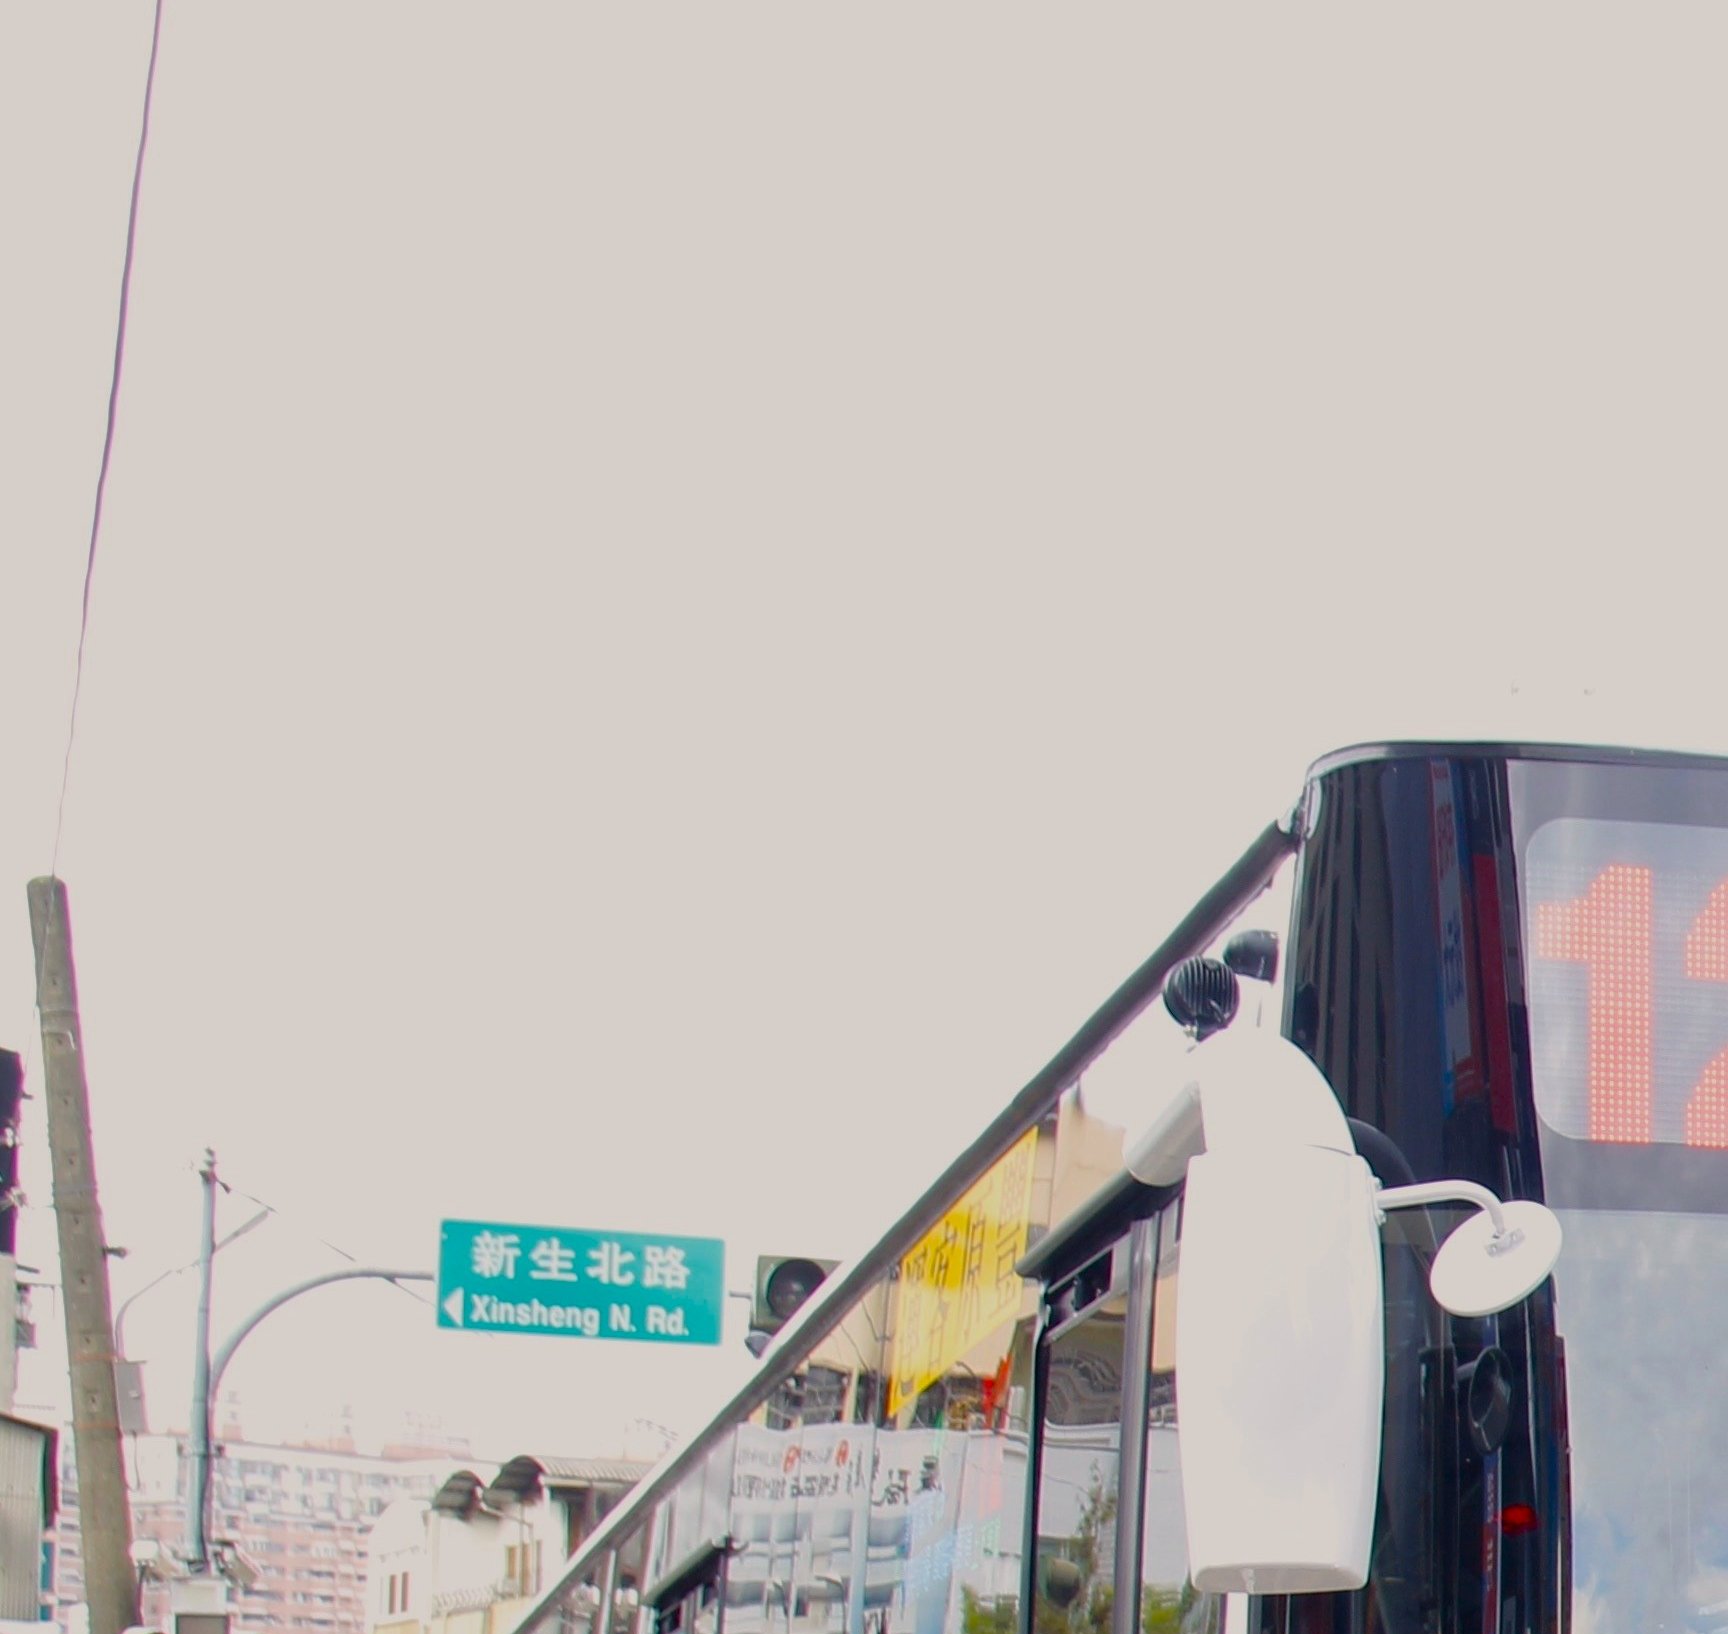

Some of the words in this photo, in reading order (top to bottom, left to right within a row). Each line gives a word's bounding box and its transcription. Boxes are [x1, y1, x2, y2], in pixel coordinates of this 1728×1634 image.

[471, 1230, 691, 1290] 新生北路
[470, 1293, 601, 1336] Xinsheng
[608, 1303, 637, 1333] N.
[645, 1304, 690, 1336] Rd.
